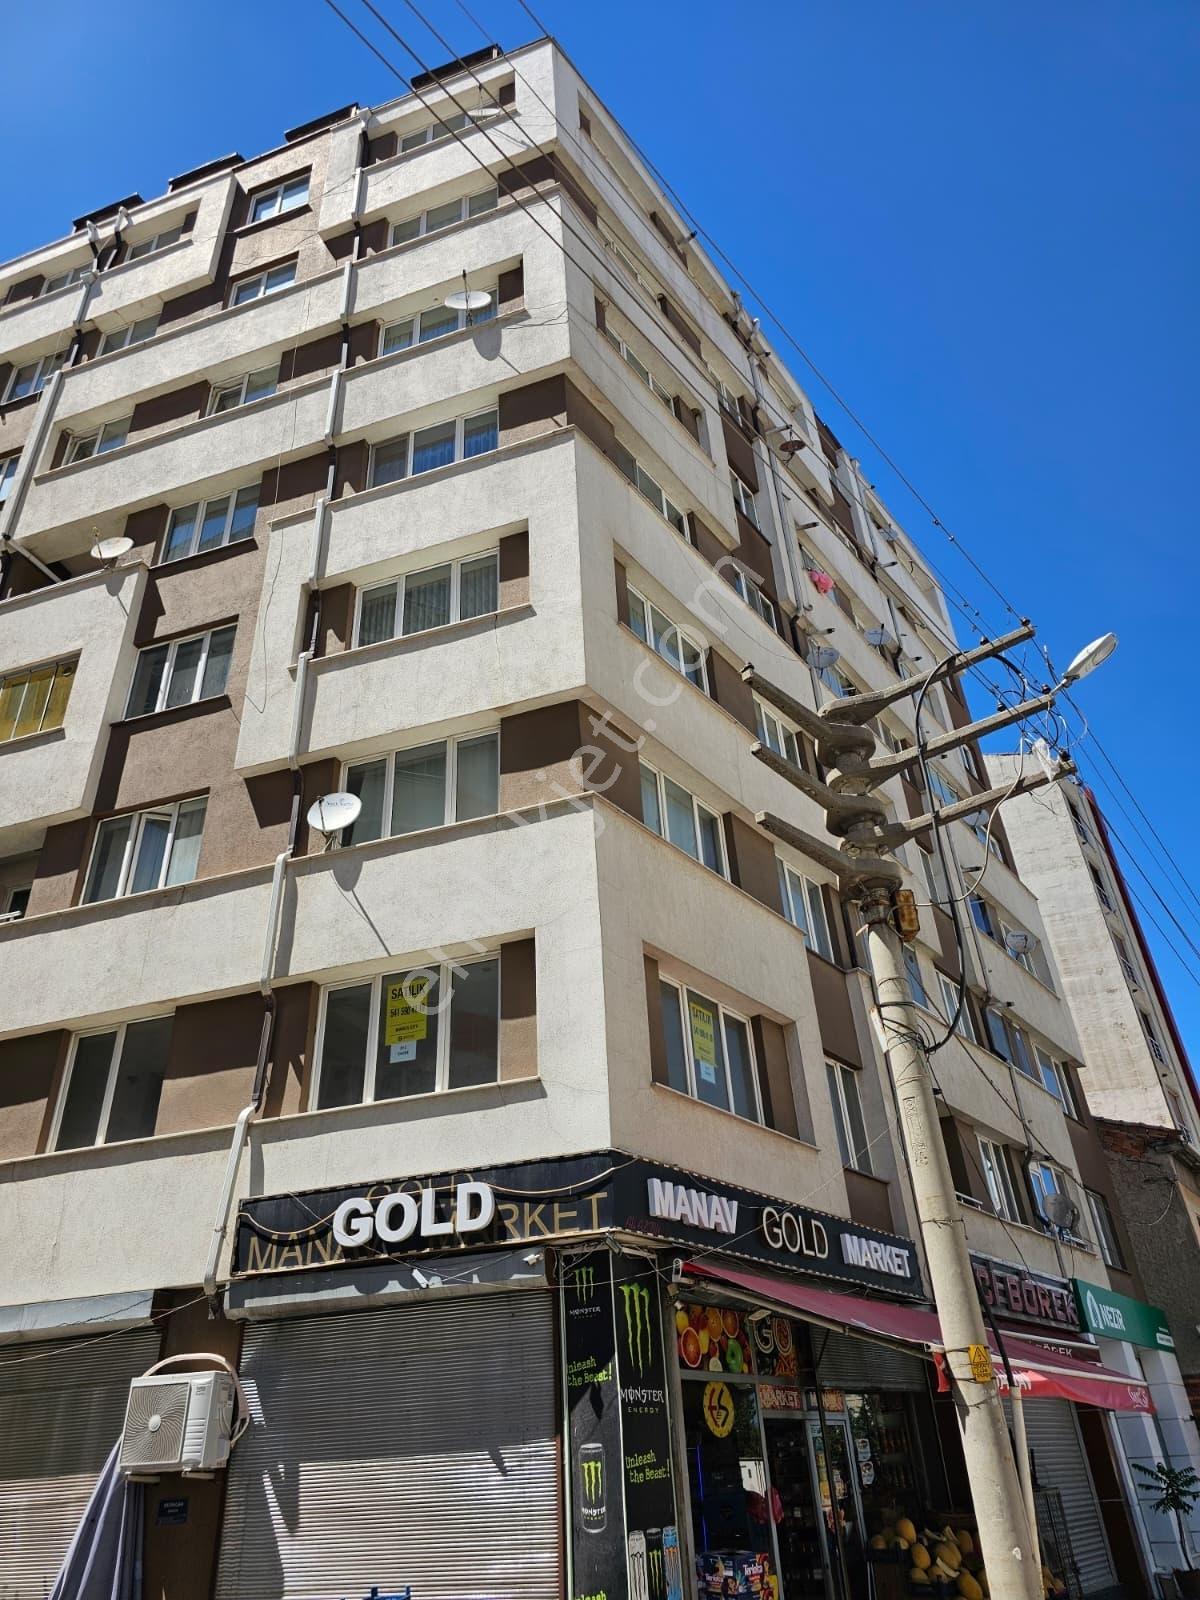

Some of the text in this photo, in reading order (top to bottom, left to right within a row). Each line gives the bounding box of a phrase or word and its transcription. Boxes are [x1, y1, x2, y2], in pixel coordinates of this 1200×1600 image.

[333, 1181, 495, 1247] GOLD
[647, 1177, 738, 1234] MANAV
[762, 1206, 829, 1259] GOLD
[840, 1233, 911, 1278] MARKET
[247, 1228, 360, 1272] MAN
[567, 1356, 597, 1374] nleash
[625, 1449, 657, 1469] Unleash
[630, 1458, 670, 1484] the Beast!
